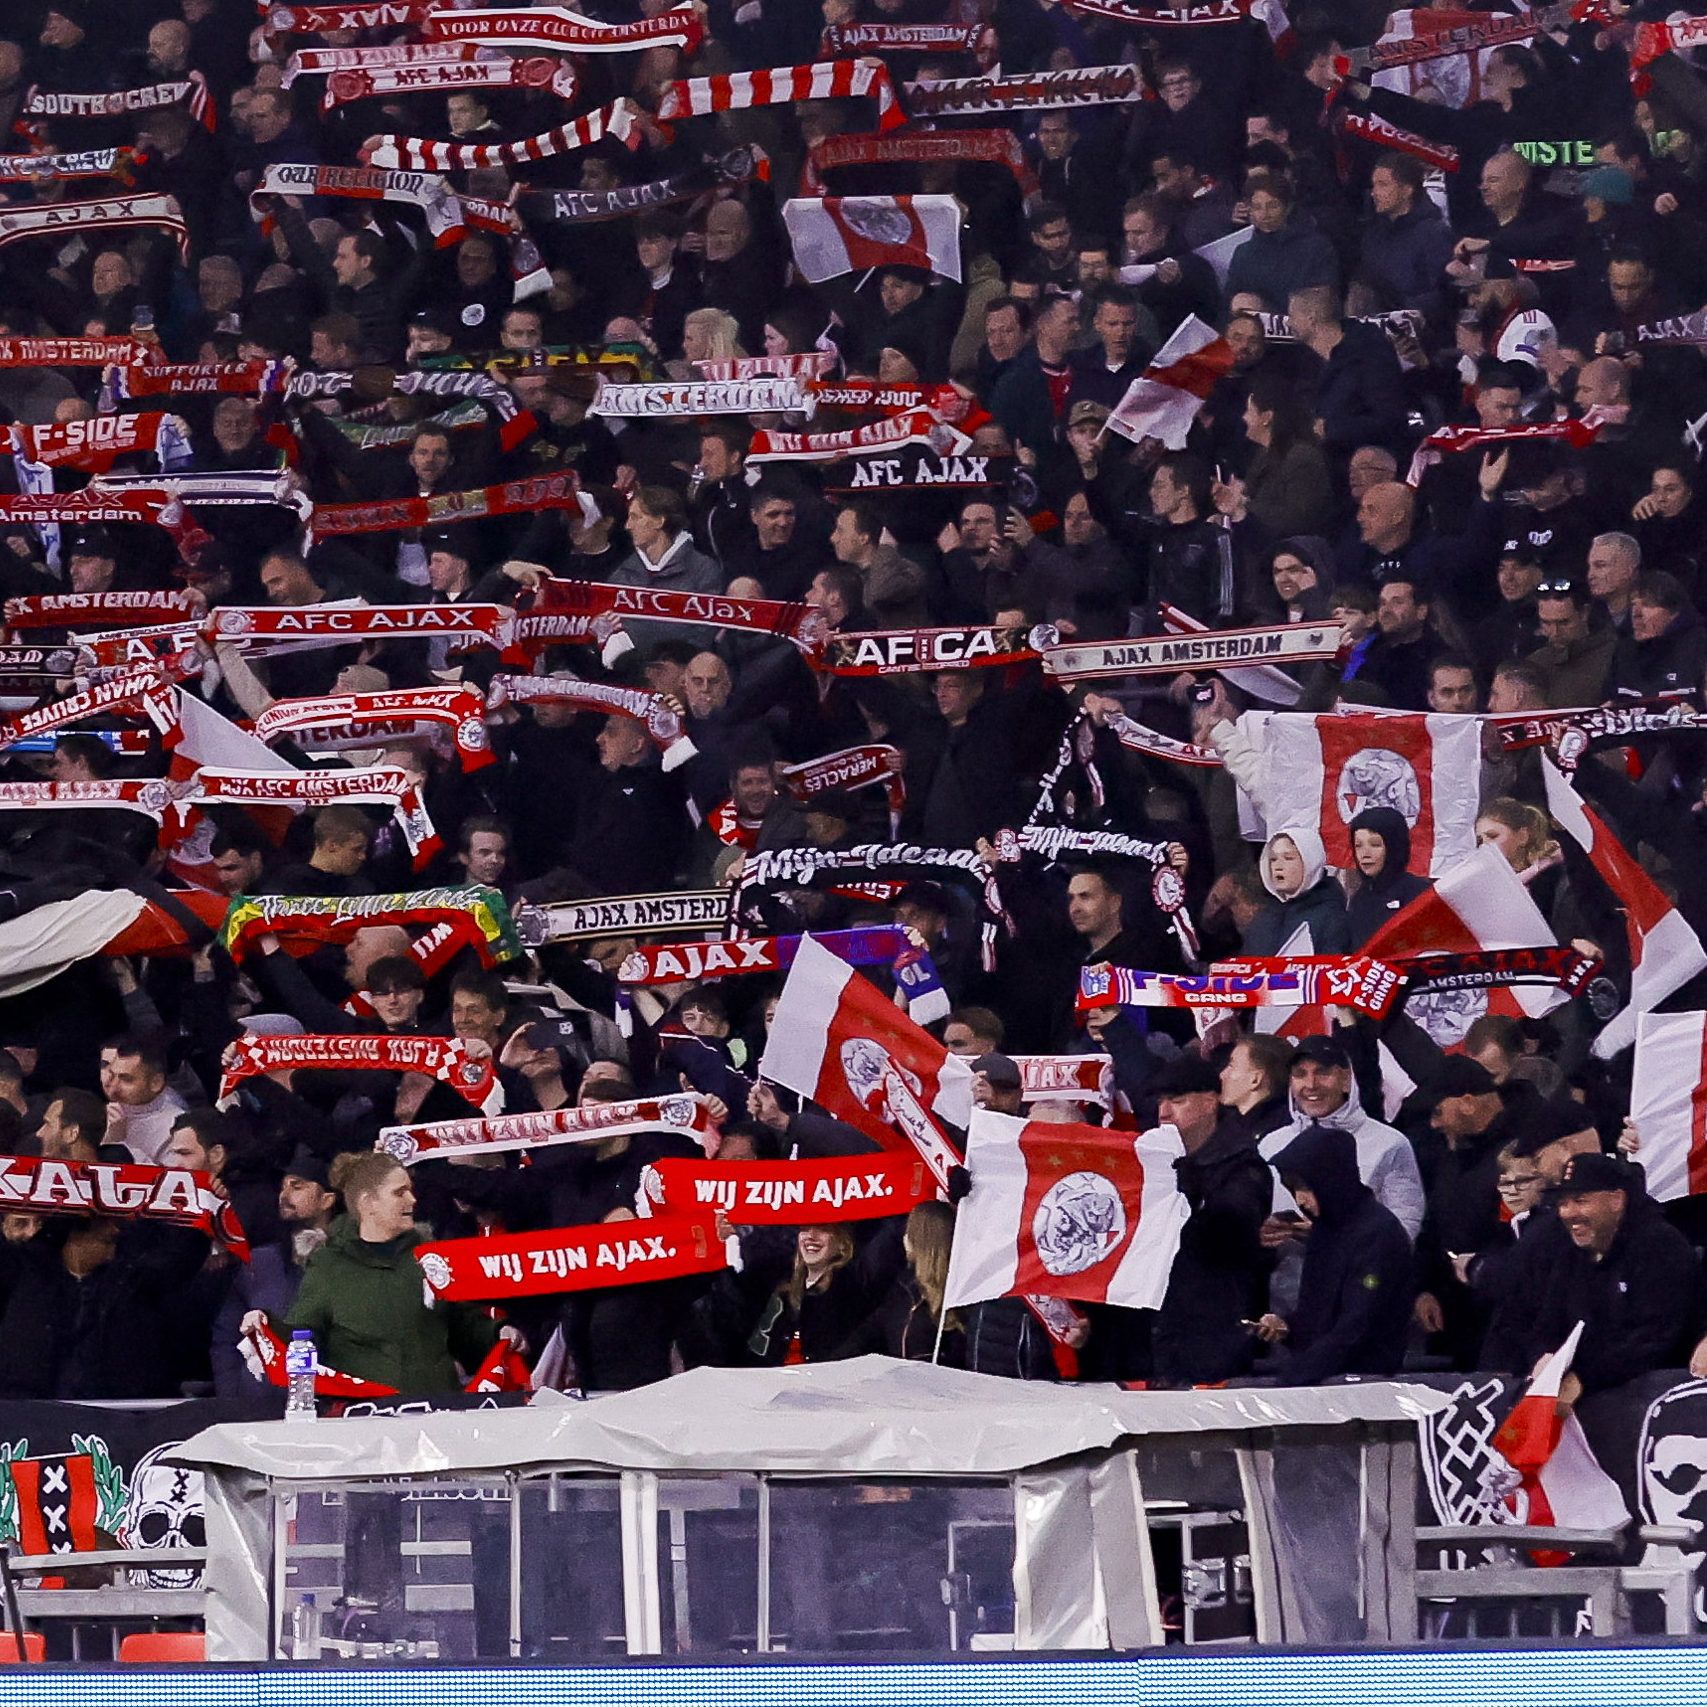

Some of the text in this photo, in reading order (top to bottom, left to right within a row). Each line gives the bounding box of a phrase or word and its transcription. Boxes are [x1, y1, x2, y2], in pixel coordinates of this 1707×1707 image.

[339, 4, 409, 28] AJAX
[441, 20, 539, 36] VOOR ONZE
[395, 69, 432, 85] AFC
[31, 82, 189, 116] SOUTH CREW
[47, 201, 134, 222] AJAX
[554, 179, 677, 219] AFC AJAX
[1638, 315, 1694, 341] AJAX
[20, 341, 132, 360] AMSTERDAM
[171, 379, 218, 391] AJAX
[33, 414, 139, 450] F-SIDE
[851, 456, 989, 486] AFC AJAX
[41, 590, 189, 613] AMSTERDAM
[615, 590, 756, 623] AFC Ajax
[277, 610, 474, 631] AFC AJAX
[1102, 634, 1284, 667] AJAX AMSTERDAM
[256, 774, 408, 795] AFC AMSTERDAM
[804, 756, 877, 792] HERACLES
[574, 897, 729, 931] AJAX AMSTERD
[654, 940, 773, 980] AJAX
[1427, 971, 1516, 989] AMSTERDAM
[1184, 993, 1247, 1003] GANG
[694, 1173, 894, 1211] WIJ ZIJN AJAX.
[478, 1235, 677, 1283] WIJ ZIJN AJAX.
